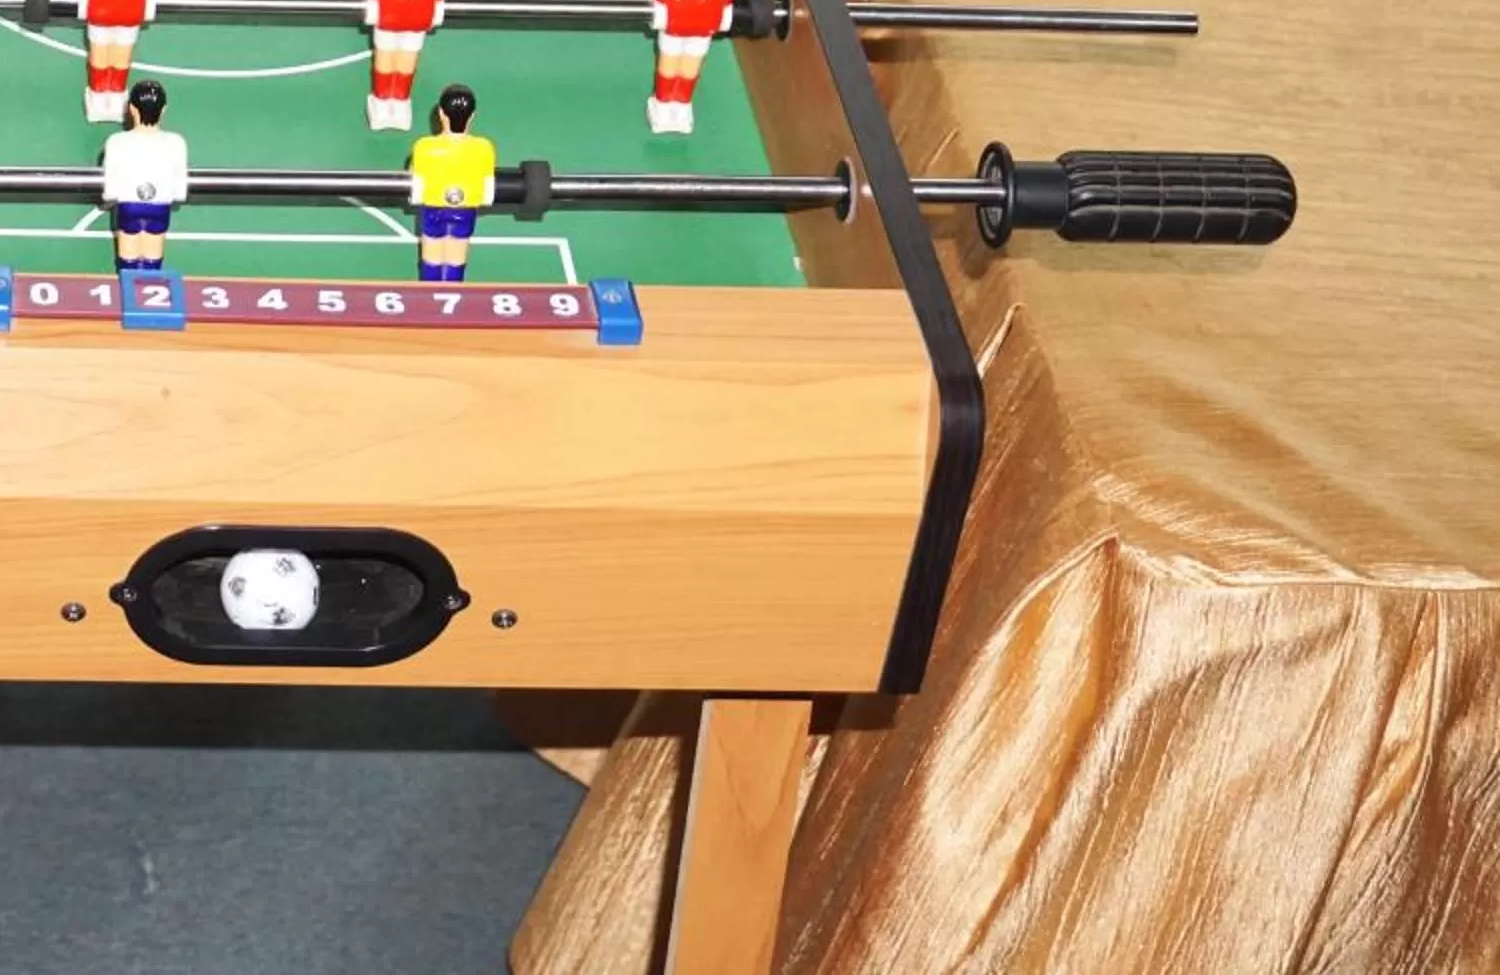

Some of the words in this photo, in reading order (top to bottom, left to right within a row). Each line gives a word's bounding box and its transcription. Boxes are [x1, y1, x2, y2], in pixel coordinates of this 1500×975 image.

[29, 282, 60, 306] 0
[89, 283, 113, 306] 1
[141, 285, 172, 308] 2
[201, 286, 230, 309] 3
[257, 288, 289, 310] 4
[318, 290, 347, 312] 5
[374, 291, 405, 314] 6
[433, 292, 462, 314] 7
[491, 293, 522, 316] 8
[549, 293, 580, 317] 9
